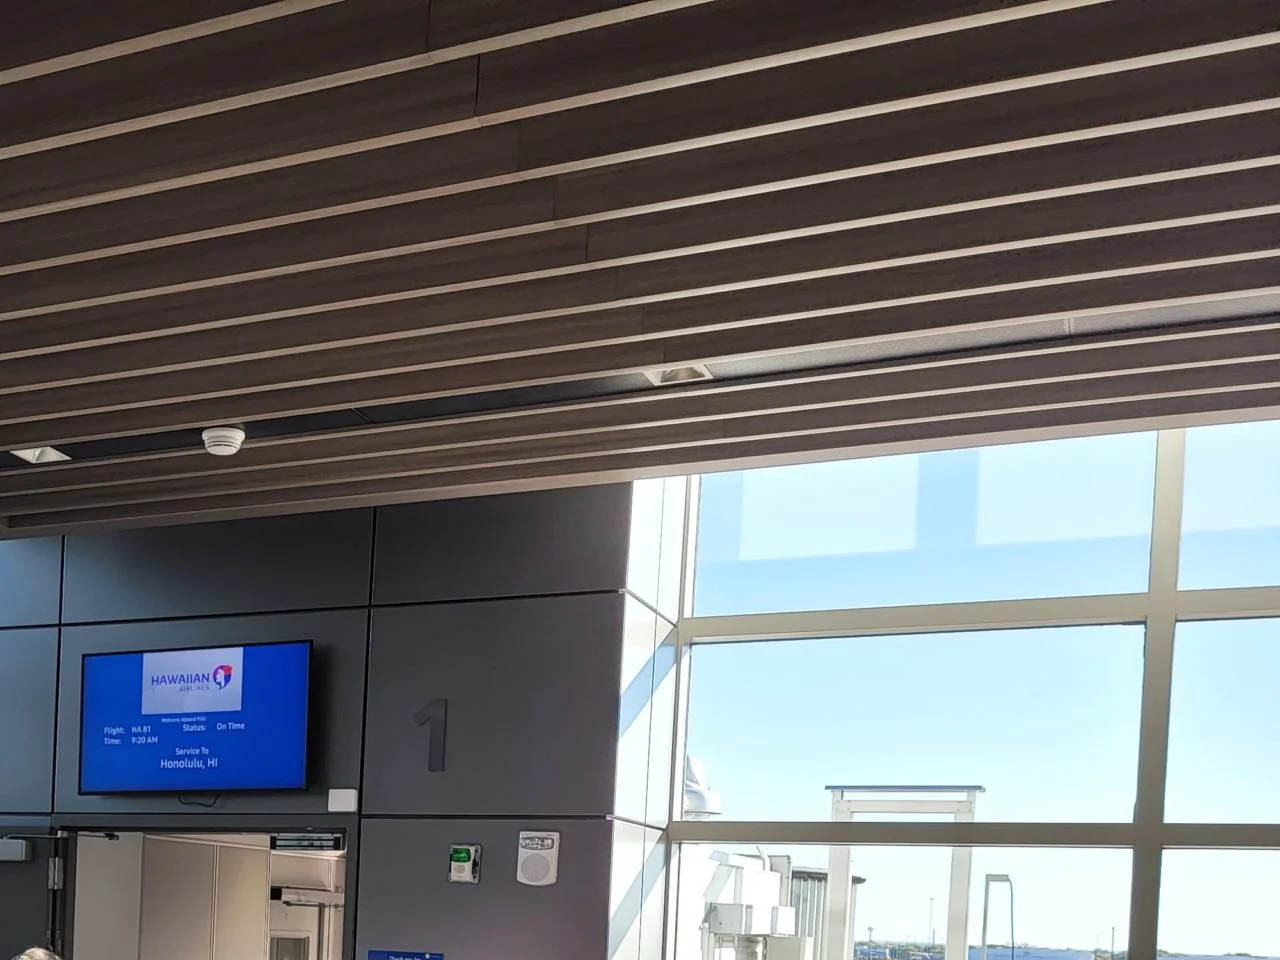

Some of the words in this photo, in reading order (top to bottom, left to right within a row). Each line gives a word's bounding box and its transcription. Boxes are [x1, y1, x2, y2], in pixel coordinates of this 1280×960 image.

[151, 673, 210, 686] HAWAIIAN
[104, 726, 125, 735] Flight:
[228, 722, 245, 730] Time
[412, 699, 448, 773] 1
[201, 747, 209, 755] To
[160, 758, 205, 770] Honolulu,
[207, 758, 218, 767] HI
